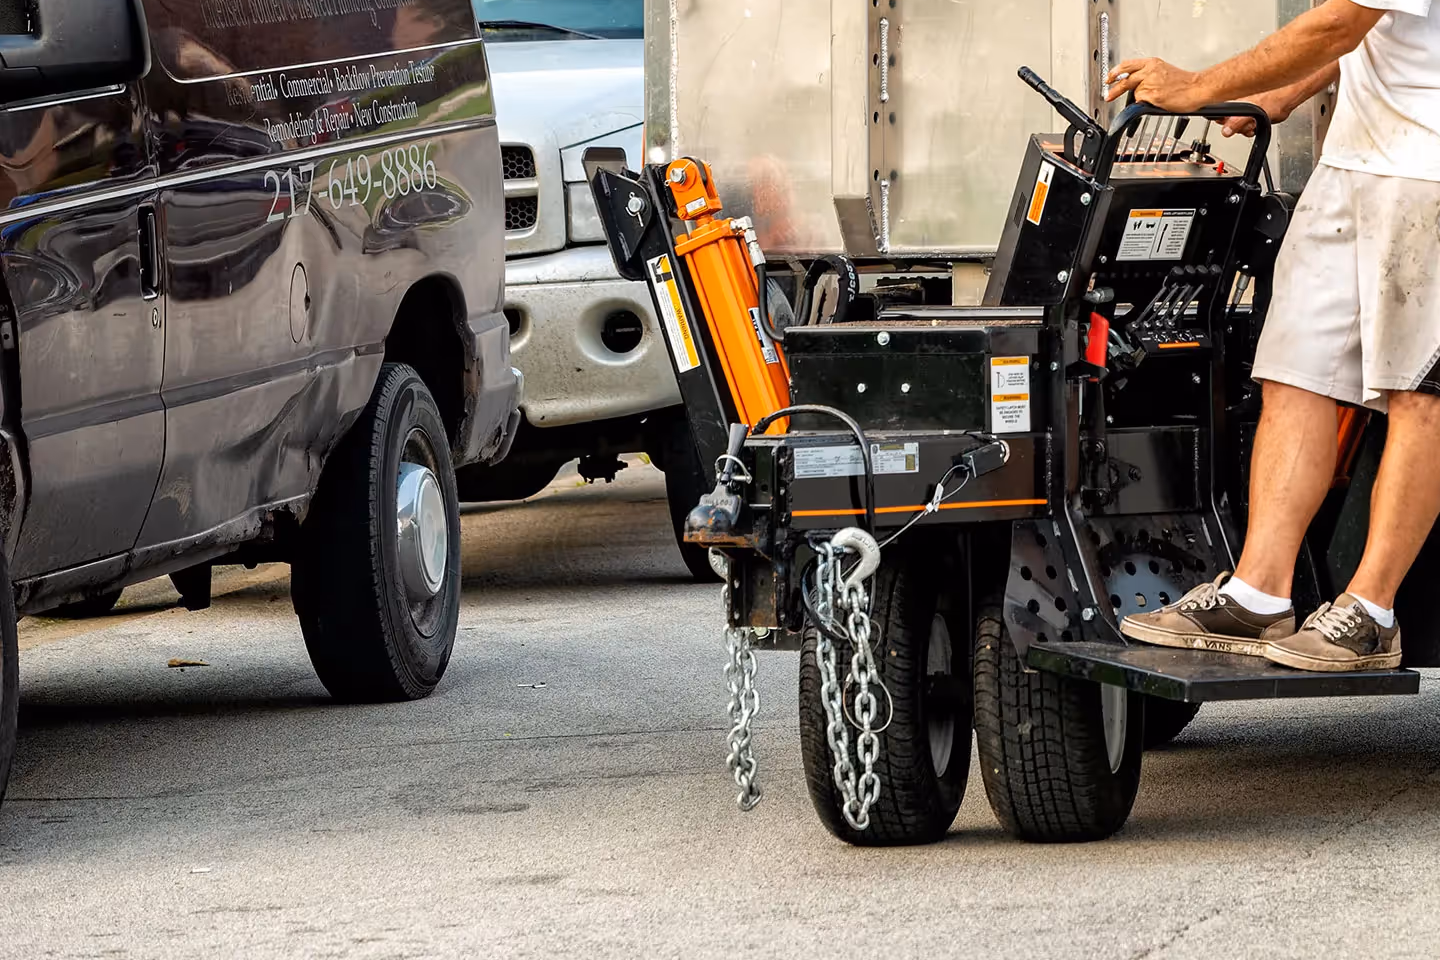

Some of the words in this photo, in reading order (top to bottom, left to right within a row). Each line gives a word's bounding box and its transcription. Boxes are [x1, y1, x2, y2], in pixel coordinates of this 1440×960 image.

[280, 68, 331, 98] Commercial
[333, 65, 371, 92] Backflow
[369, 62, 411, 88] Prevention
[408, 60, 435, 84] Testing
[263, 111, 317, 144] Remodeling
[314, 108, 325, 135] &
[322, 105, 351, 140] Repair
[353, 102, 373, 128] New
[372, 96, 419, 124] Construction
[264, 141, 438, 224] 217-649-8886
[1204, 640, 1232, 652] VANS
